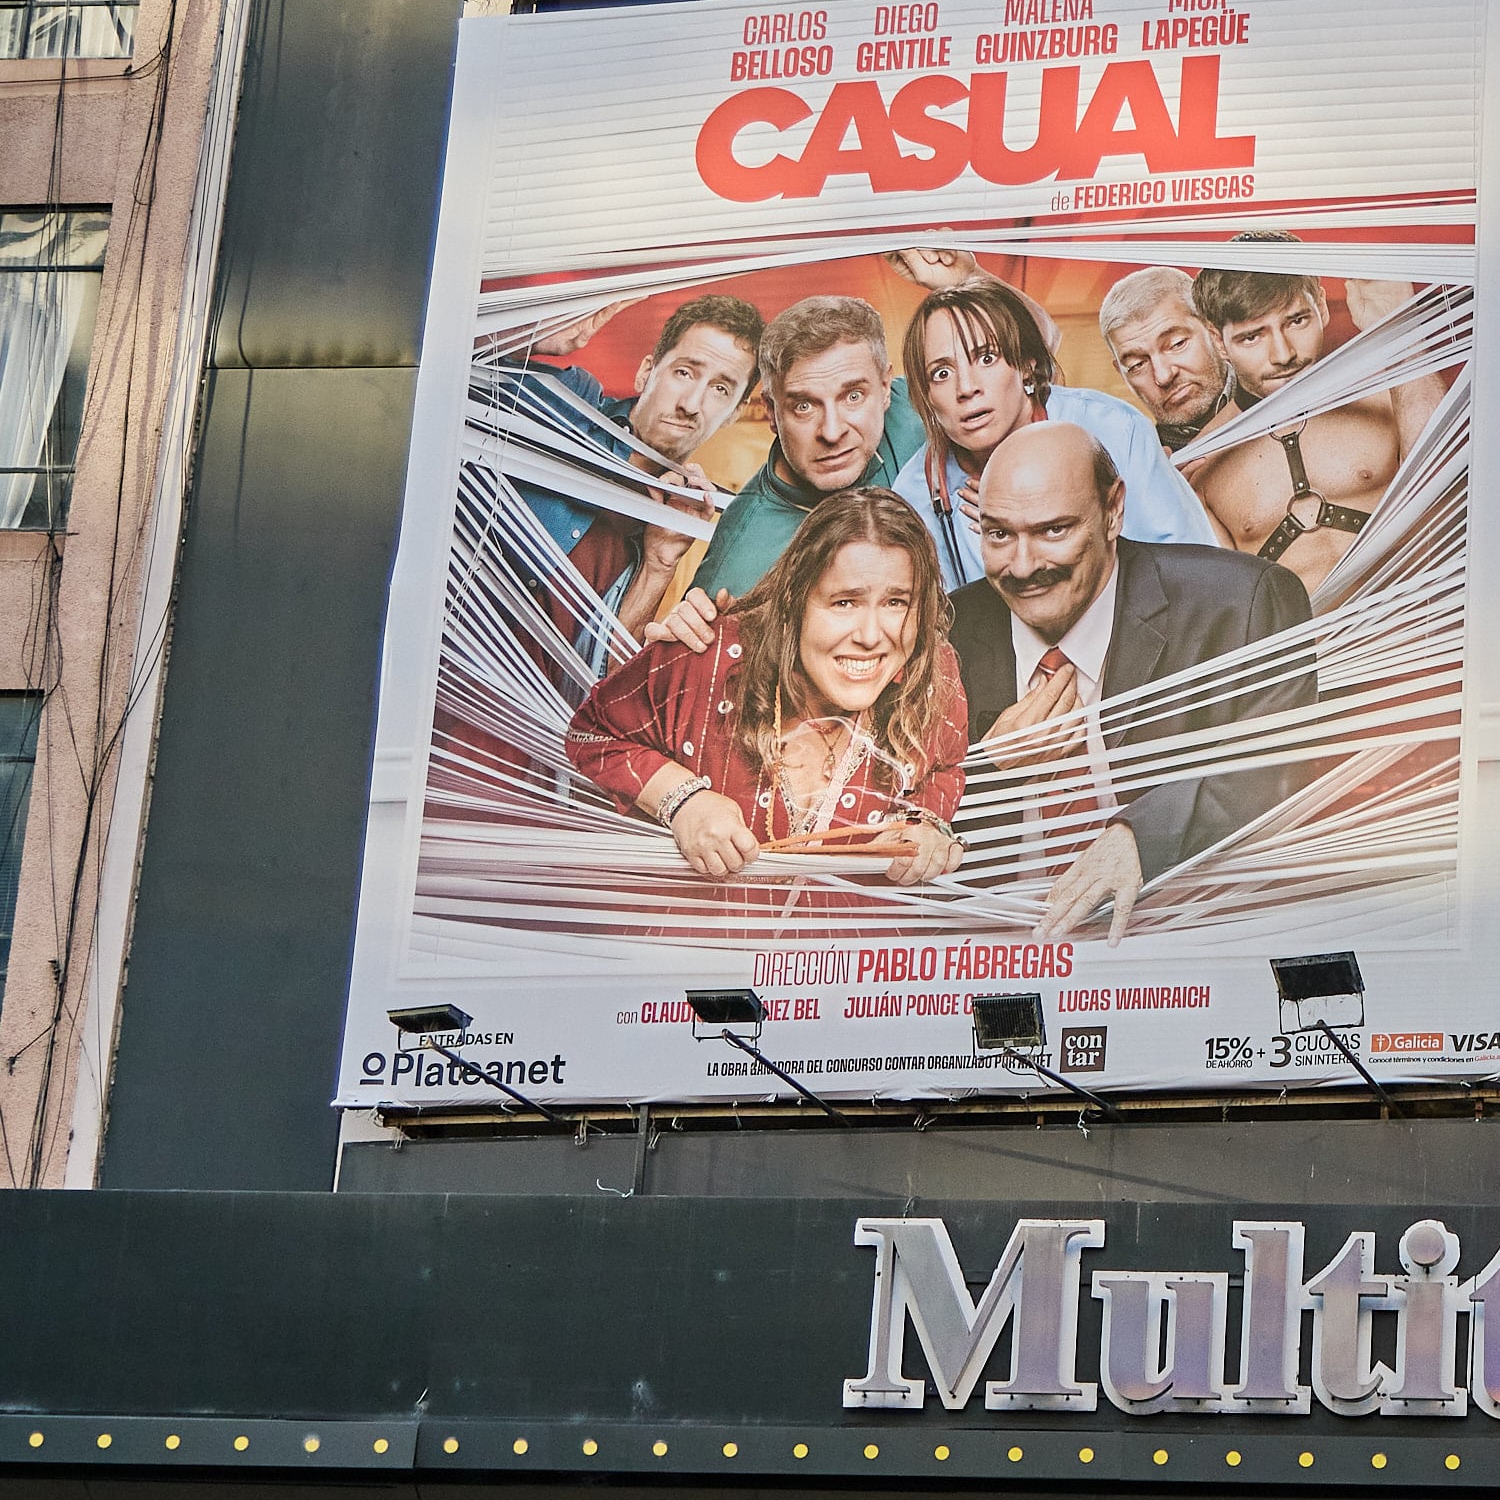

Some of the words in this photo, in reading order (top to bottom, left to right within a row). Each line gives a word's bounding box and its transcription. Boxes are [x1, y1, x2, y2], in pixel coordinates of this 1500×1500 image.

[730, 45, 834, 81] BELLOSO
[856, 36, 951, 72] GENTILE
[976, 24, 1118, 65] GUINZBURG
[1142, 10, 1250, 51] LAPEGÜE
[743, 11, 828, 46] CARLOS
[875, 2, 938, 35] DIEGO
[695, 54, 1256, 202] CASUAL
[1073, 180, 1166, 208] FEDERICO
[1171, 175, 1254, 202] VIESCAS
[753, 944, 849, 987] DIRECCIÓN
[857, 946, 940, 983] PABLO
[944, 939, 1074, 980] FÁBREGAS
[1059, 989, 1112, 1013] LUCAS
[1115, 986, 1211, 1011] WAINRAICH
